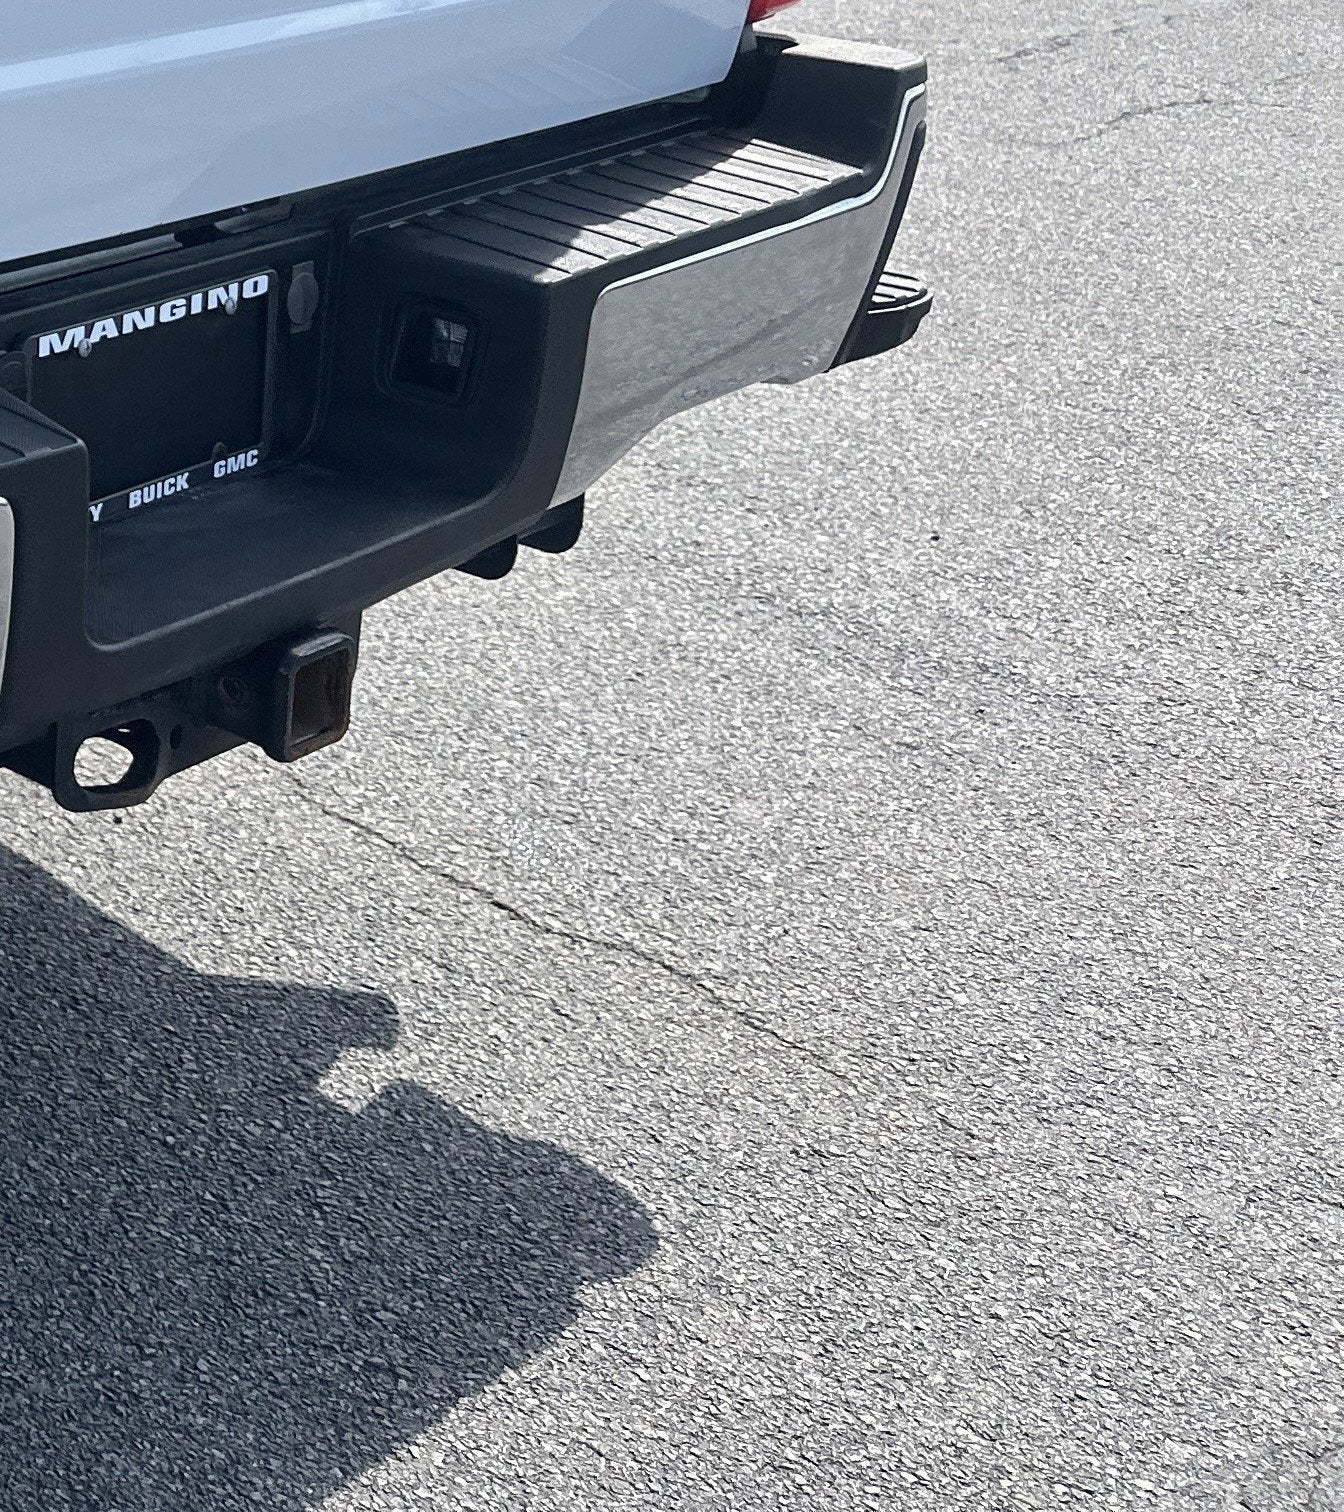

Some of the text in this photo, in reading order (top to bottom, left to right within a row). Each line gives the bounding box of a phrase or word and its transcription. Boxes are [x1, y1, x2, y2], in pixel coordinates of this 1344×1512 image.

[37, 274, 269, 358] MANGINO
[128, 449, 259, 509] BUICK GMC
